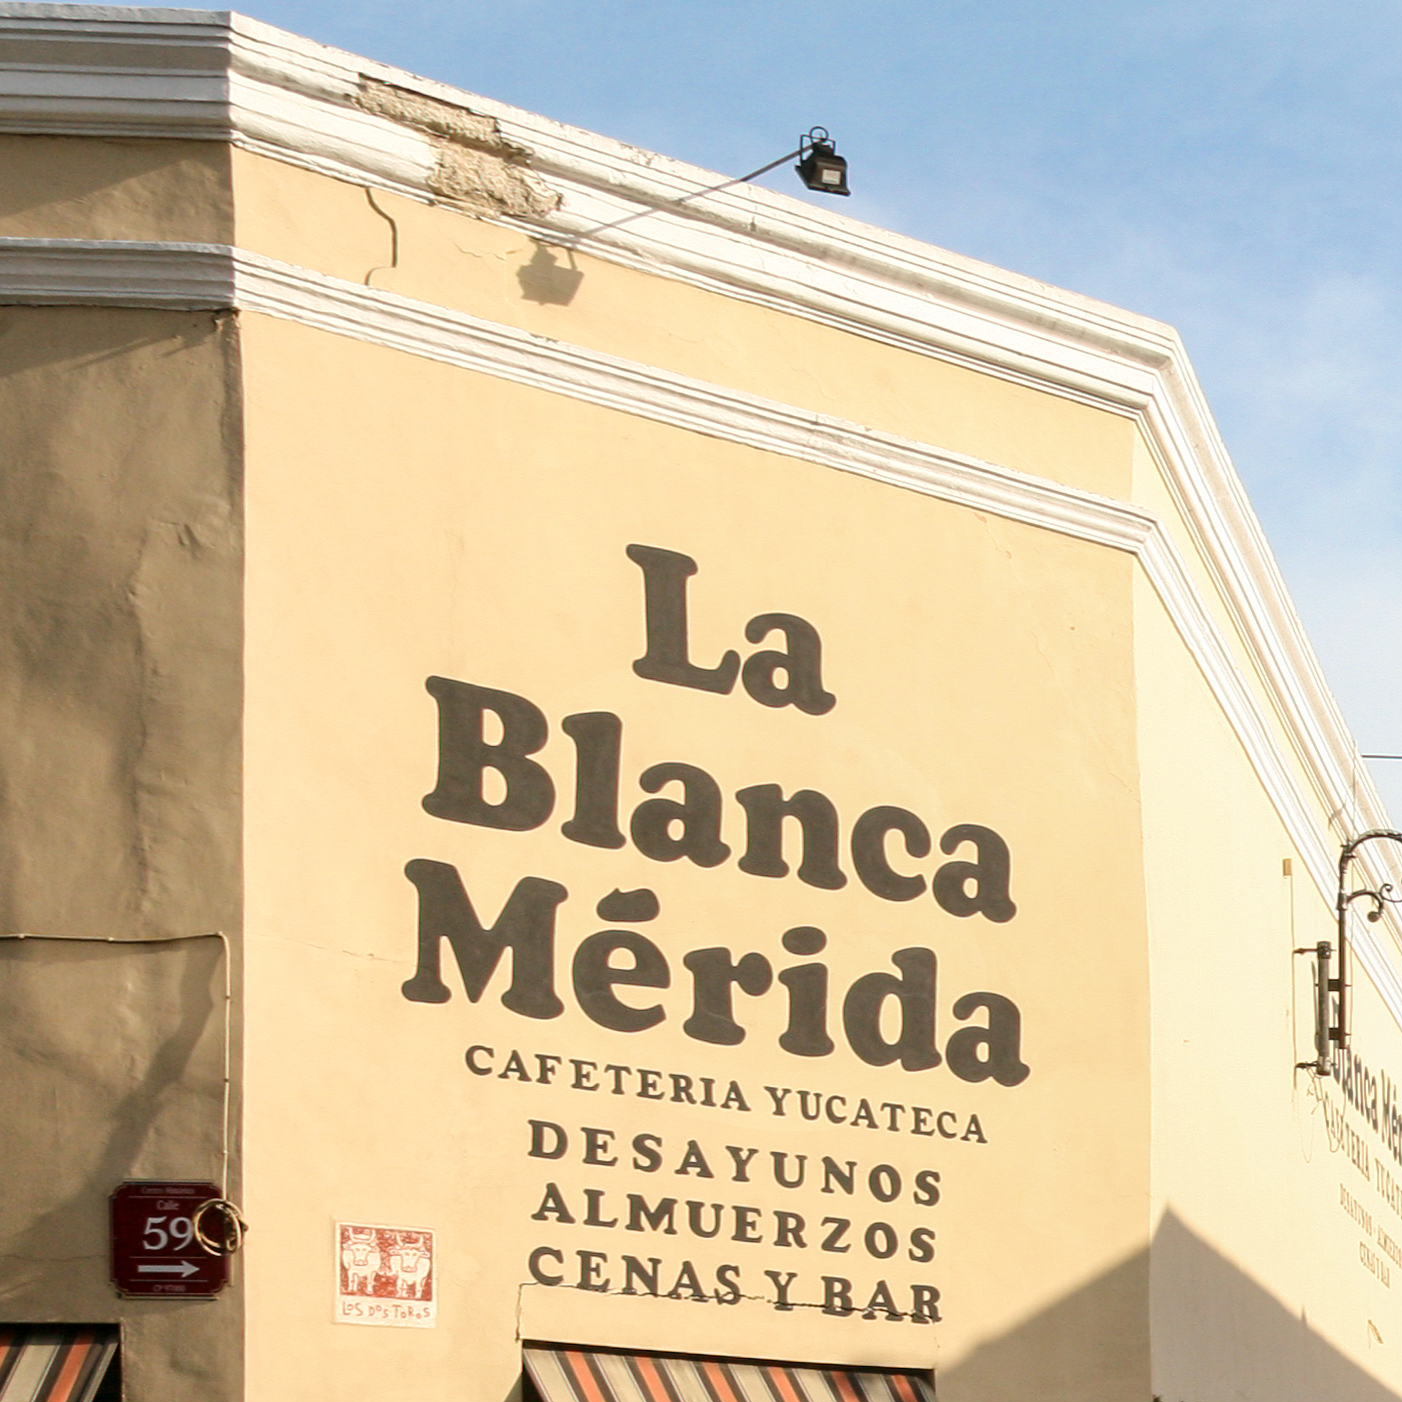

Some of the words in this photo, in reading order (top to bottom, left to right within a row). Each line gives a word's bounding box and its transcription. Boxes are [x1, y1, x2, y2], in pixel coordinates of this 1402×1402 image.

[625, 543, 836, 716] La
[421, 675, 1018, 924] Blanca
[401, 858, 1030, 1087] Mérida
[465, 1045, 750, 1111] CAFETERIA
[765, 1086, 988, 1144] YUCATECA
[528, 1119, 942, 1207] DESAYUNOS
[142, 1216, 194, 1251] 59
[531, 1182, 938, 1264] ALMUERZOS
[528, 1247, 742, 1306] CENAS
[765, 1270, 799, 1311] Y
[822, 1276, 943, 1324] BAR
